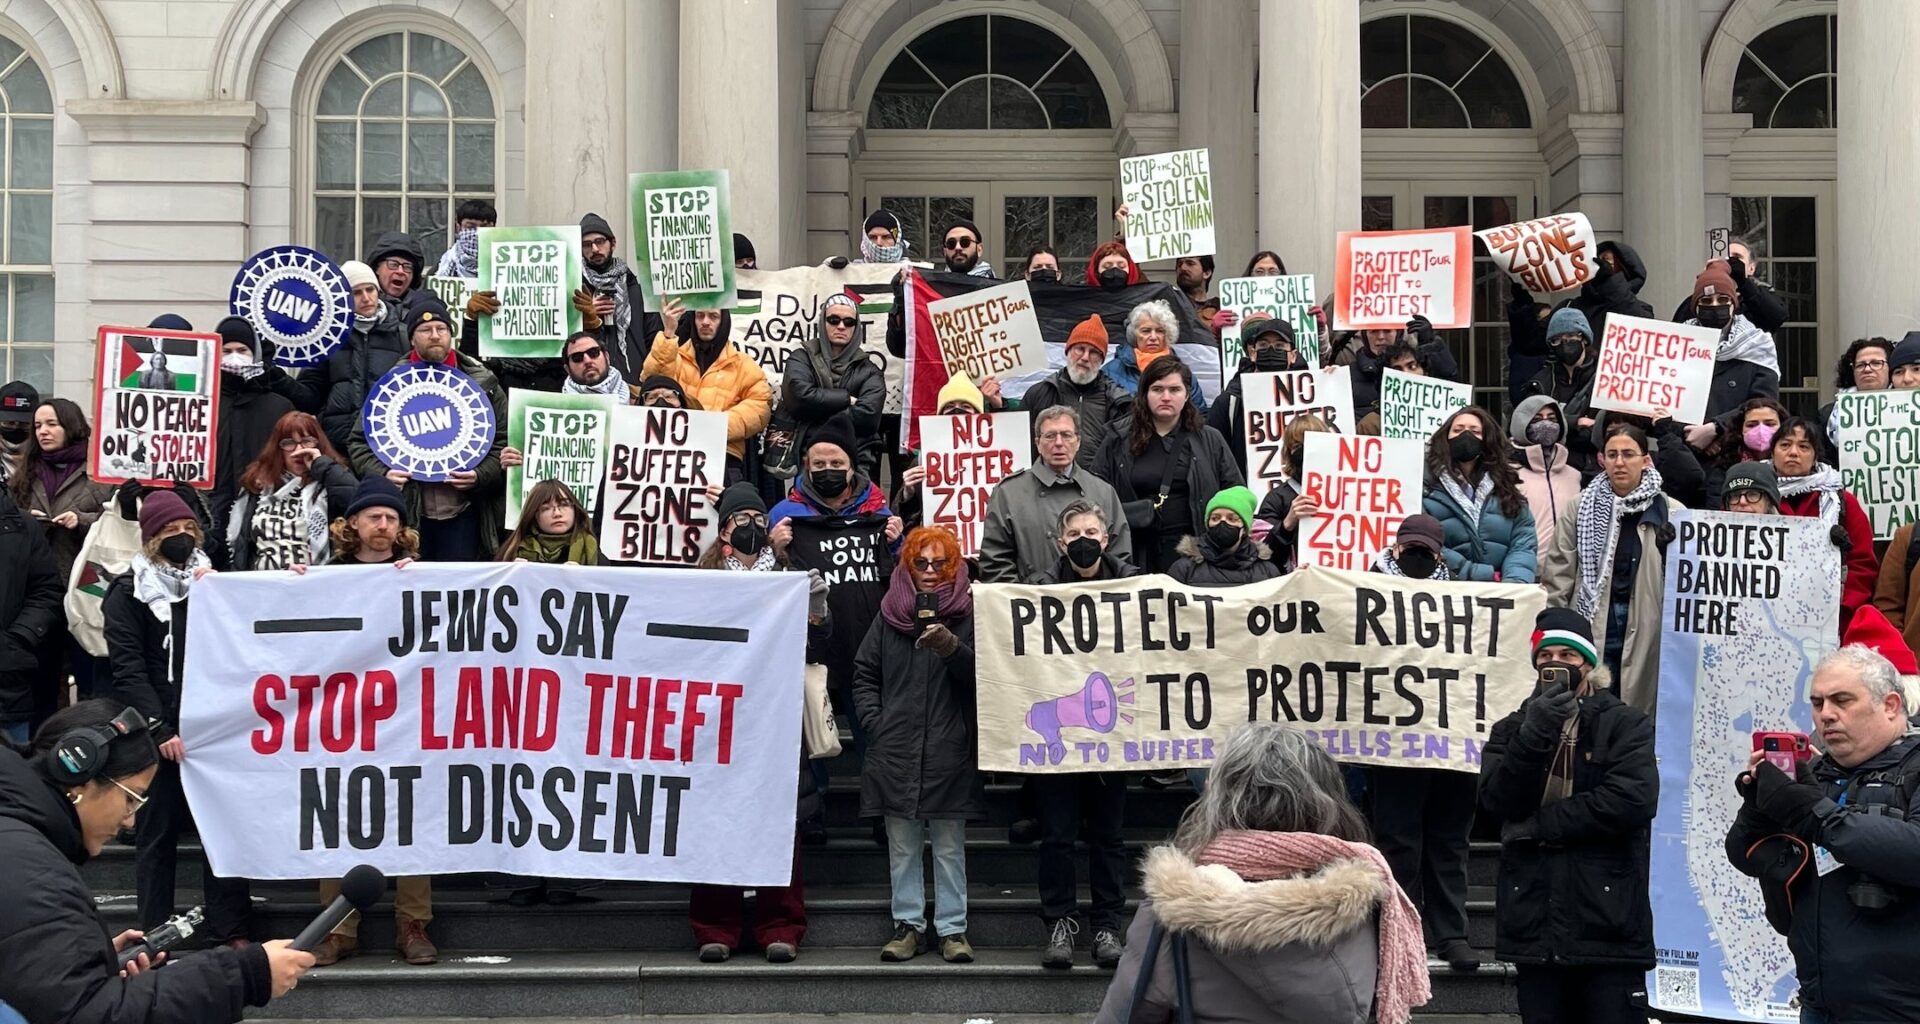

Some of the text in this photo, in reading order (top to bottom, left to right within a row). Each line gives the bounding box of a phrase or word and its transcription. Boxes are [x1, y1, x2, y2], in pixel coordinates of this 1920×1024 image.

[1123, 151, 1208, 185] STOP THE SALE
[650, 190, 710, 214] STOP
[1127, 176, 1209, 211] OF STOLEN
[651, 215, 711, 237] FINANCING
[1127, 202, 1212, 238] PALESTINIAN
[496, 245, 558, 263] STOP
[1146, 233, 1192, 259] LAND
[1355, 249, 1451, 273] PROTECT OUR
[1500, 221, 1585, 273] ZONE
[496, 265, 558, 284] FINANCING
[652, 261, 717, 290] IN PALESTINE
[1354, 274, 1421, 295] RIGHT TO
[1521, 250, 1589, 292] BILLS
[267, 288, 318, 323] UAW
[430, 278, 465, 306] STOP
[1222, 276, 1313, 307] STOP THE SALE
[1353, 295, 1431, 318] PROTEST
[493, 309, 561, 336] IN PALESTINE
[933, 296, 1030, 338] PROTECT OUR
[940, 329, 1007, 361] RIGHT TO
[1606, 323, 1712, 362] PROTECT OUR
[1601, 349, 1677, 378] RIGHT TO
[1274, 372, 1315, 407] NO
[1385, 375, 1466, 410] PROTECT OUR
[1597, 374, 1686, 409] PROTEST
[116, 392, 209, 433] NO PEACE
[403, 406, 452, 436] UAW
[529, 411, 597, 435] STOP
[645, 409, 689, 446] NO
[1384, 402, 1442, 429] RIGHT TO
[1840, 395, 1888, 428] STOP
[1889, 403, 1909, 413] THE
[103, 434, 207, 462] ON STOLEN
[528, 434, 595, 459] FINANCING
[952, 413, 993, 449] NO
[1844, 440, 1862, 452] OF
[151, 462, 206, 482] LAND!
[610, 444, 708, 486] BUFFER
[926, 450, 1013, 487] BUFFER
[1338, 437, 1382, 473] NO
[1306, 472, 1404, 514] BUFFER
[1729, 478, 1754, 489] RESIST
[614, 483, 708, 526] ZONE
[621, 522, 700, 563] BILLS
[820, 535, 861, 552] NOT
[832, 547, 876, 566] OUR
[1679, 521, 1790, 561] PROTEST
[1676, 559, 1781, 599] BANNED
[388, 585, 630, 660] JEWS SAY
[1011, 587, 1514, 657] PROTECT OUR RIGHT
[1674, 598, 1739, 636] HERE
[251, 670, 397, 754] STOP
[421, 666, 561, 752] LAND
[584, 672, 744, 765] THEFT
[1146, 672, 1212, 730] TO
[1019, 743, 1065, 766] NO
[1075, 741, 1109, 763] TO
[1123, 738, 1216, 762] BUFFER
[1402, 733, 1448, 759] IN
[299, 763, 691, 857] NOT DISSENT
[1671, 949, 1684, 958] FULL
[1686, 950, 1699, 959] MAP
